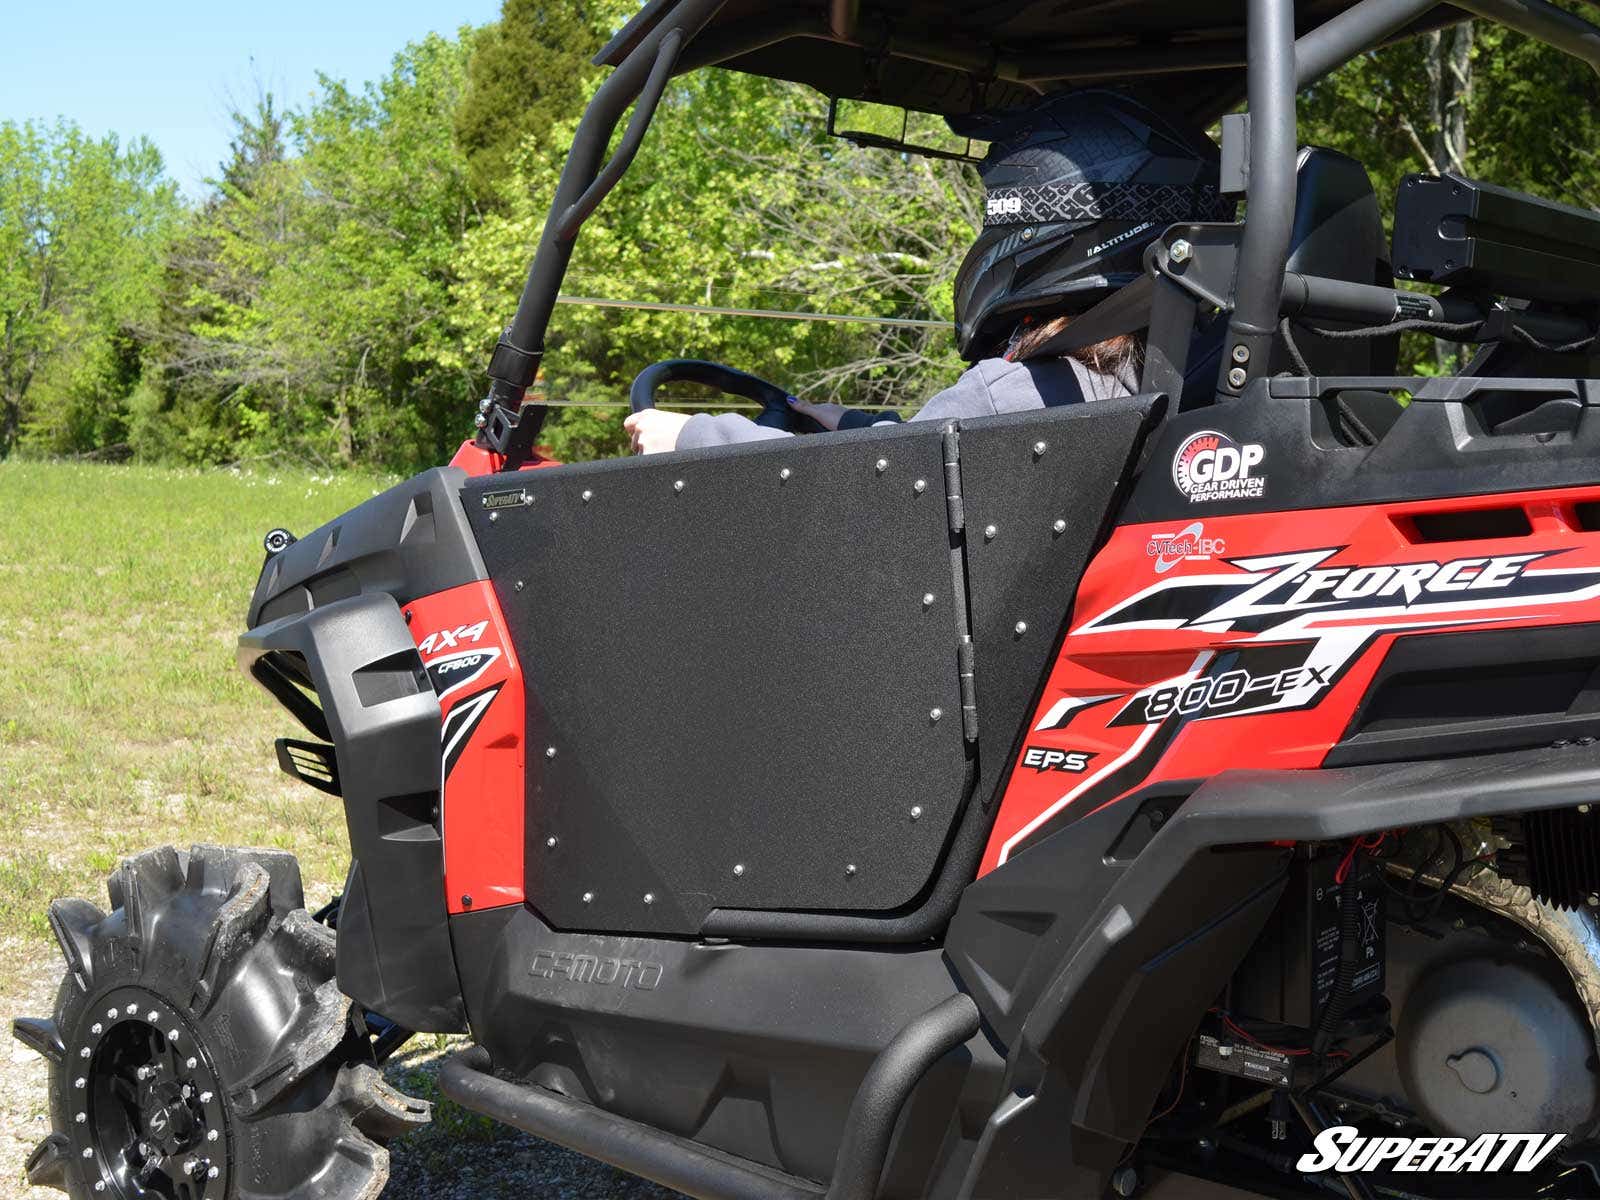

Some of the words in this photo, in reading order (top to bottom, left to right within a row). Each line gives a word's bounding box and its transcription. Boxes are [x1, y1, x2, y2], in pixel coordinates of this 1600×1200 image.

[986, 197, 1021, 216] 509
[1189, 444, 1264, 483] GDP
[1190, 482, 1218, 494] GEAR
[1220, 477, 1264, 489] DRIVEN
[1190, 487, 1263, 503] PERFORMANCE
[1144, 664, 1332, 722] 800-EX
[1024, 748, 1089, 771] EPS
[527, 950, 664, 991] CFMOTO
